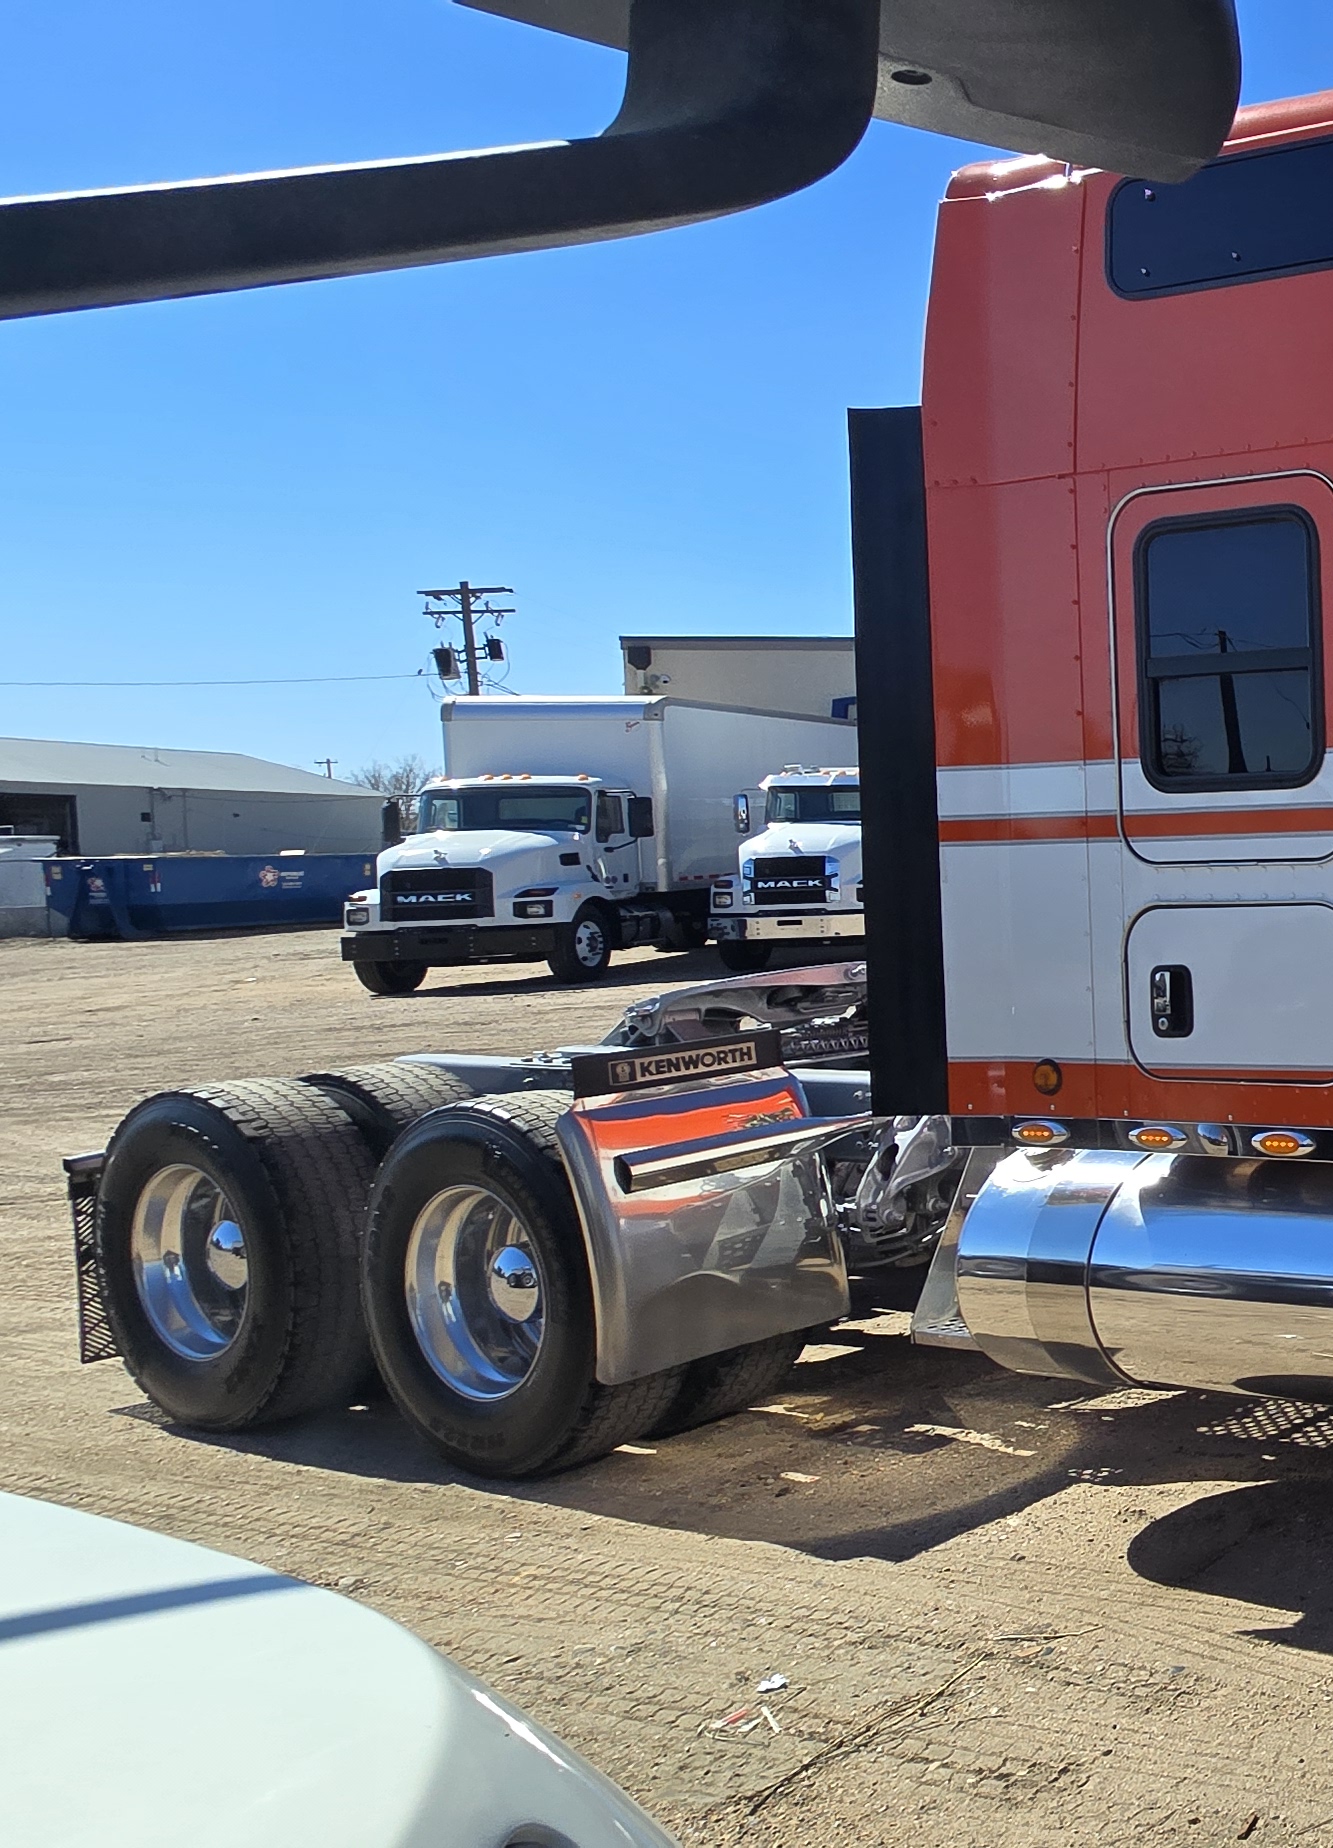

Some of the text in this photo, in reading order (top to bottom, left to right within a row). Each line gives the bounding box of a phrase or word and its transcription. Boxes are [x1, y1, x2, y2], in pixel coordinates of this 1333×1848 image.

[757, 879, 823, 889] MACK
[396, 892, 473, 904] MACK
[639, 1046, 753, 1078] KENWORTH
